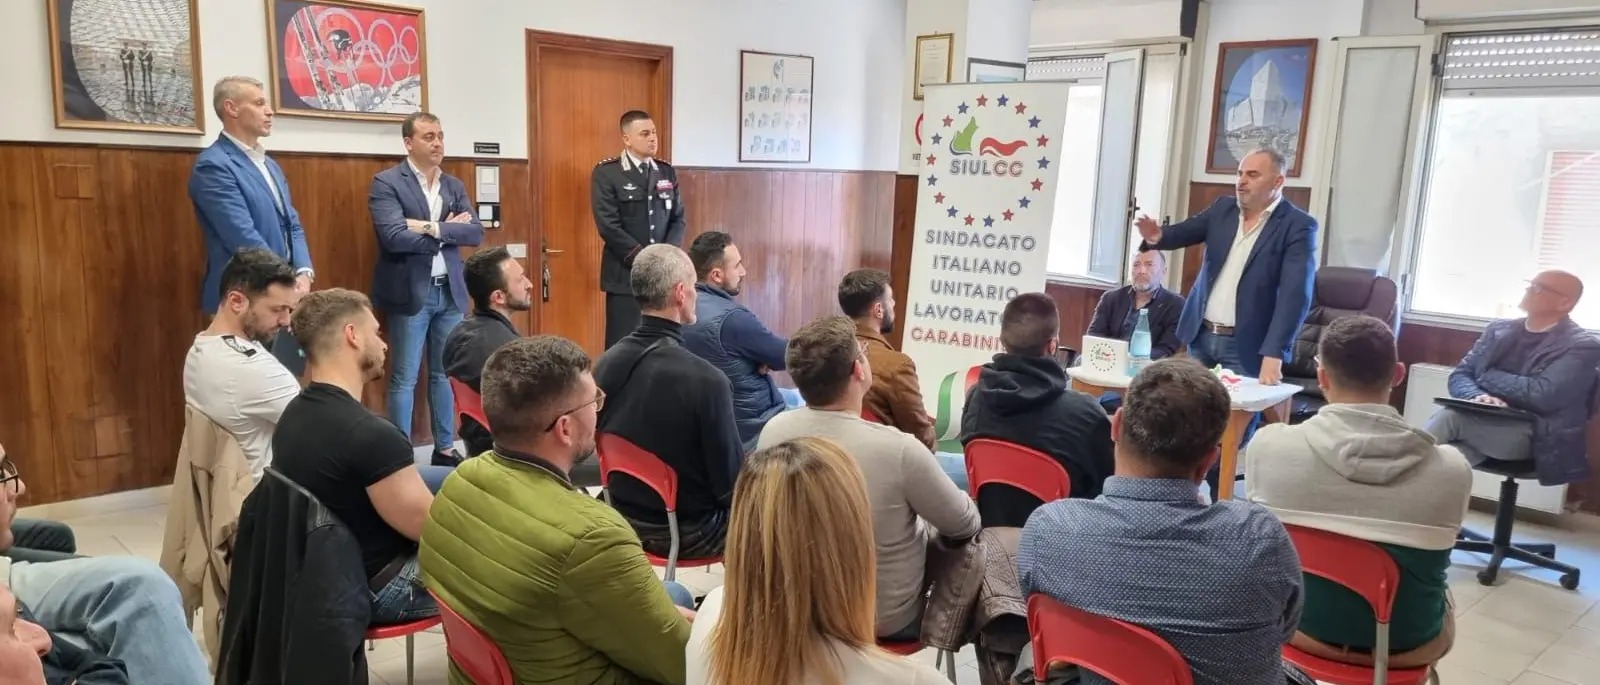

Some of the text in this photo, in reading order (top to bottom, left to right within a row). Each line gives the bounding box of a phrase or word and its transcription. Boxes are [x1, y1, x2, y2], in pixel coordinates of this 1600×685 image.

[950, 159, 1024, 177] SIULCC
[925, 229, 1036, 251] SINDACATO
[932, 254, 1022, 276] ITALIANO
[930, 279, 1019, 301] UNITARIO
[914, 302, 1004, 325] LAVORAT
[911, 326, 1006, 352] CARABINI
